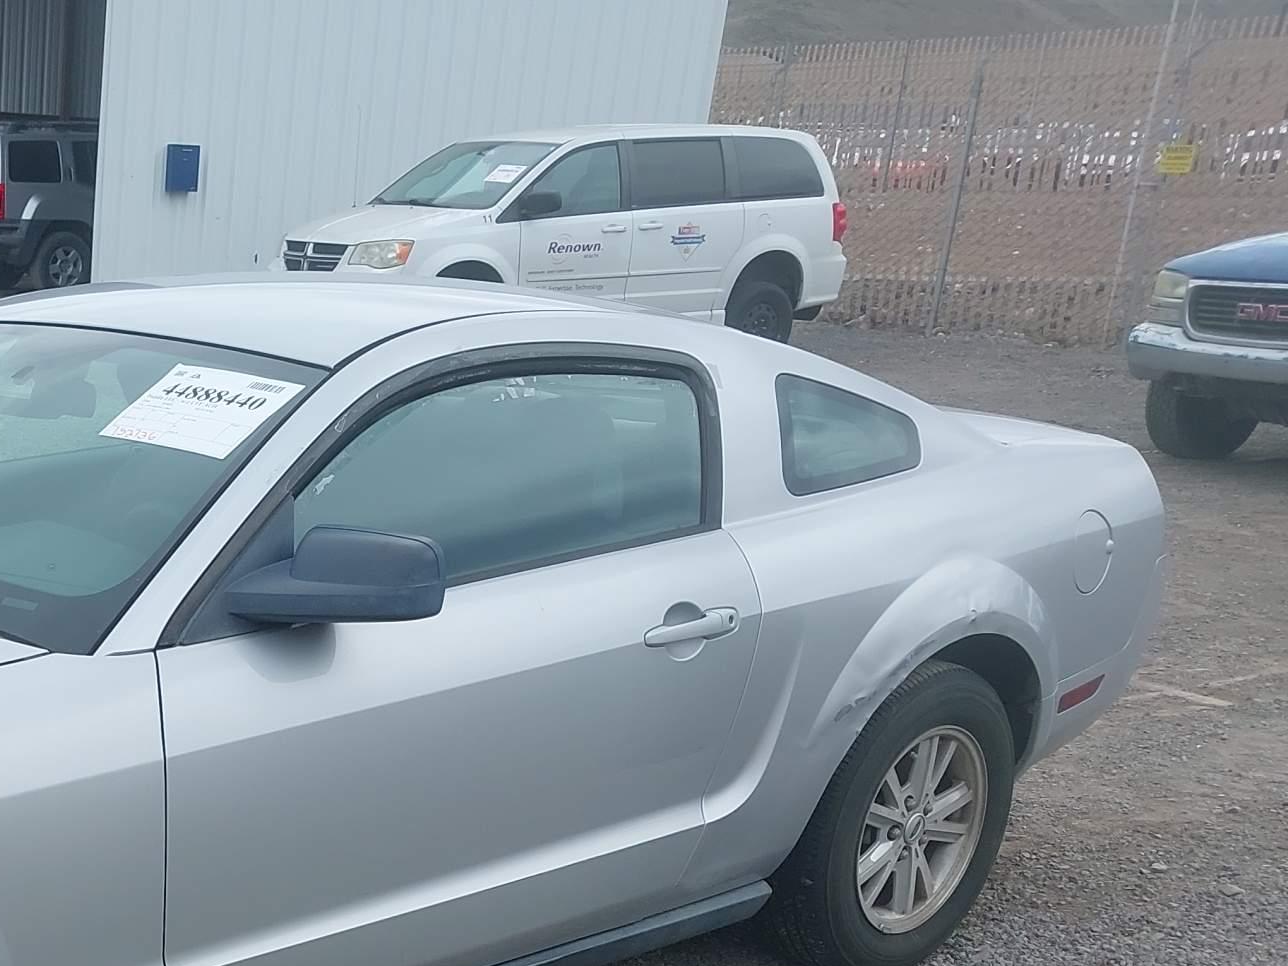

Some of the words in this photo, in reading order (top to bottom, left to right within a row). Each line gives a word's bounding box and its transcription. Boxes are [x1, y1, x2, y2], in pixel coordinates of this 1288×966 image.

[482, 214, 493, 223] 11
[547, 241, 602, 254] Renown
[1237, 302, 1288, 322] GMC
[162, 383, 267, 411] 44888440
